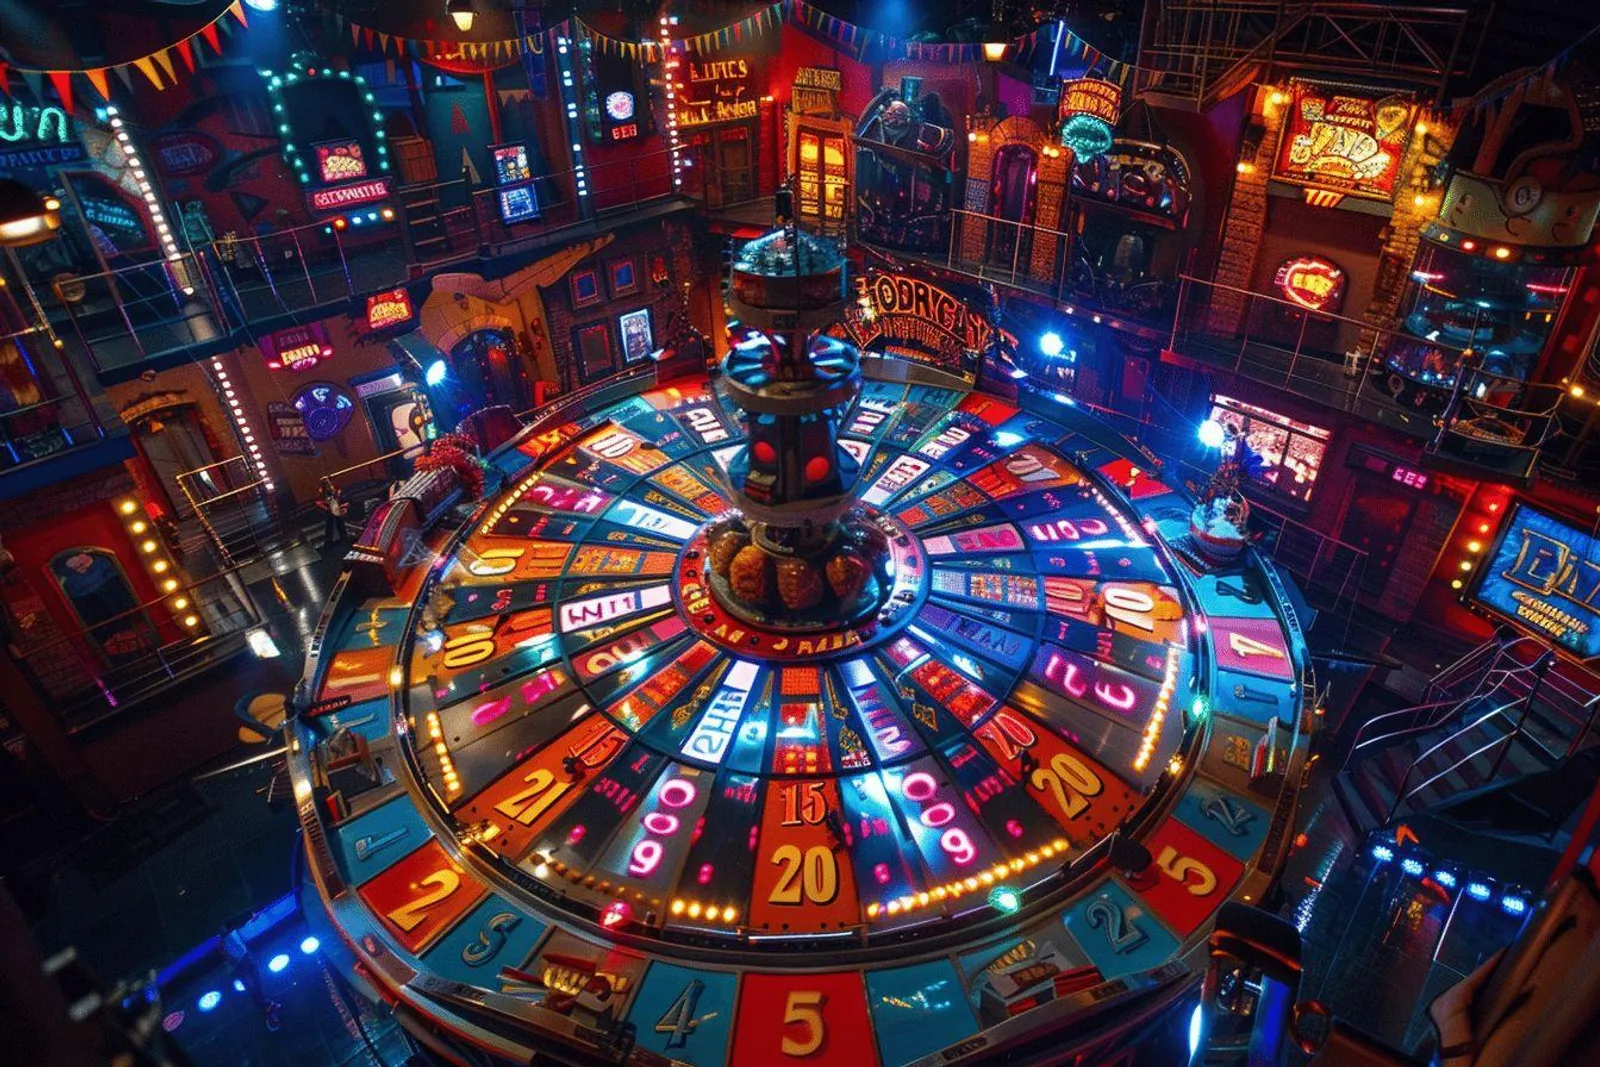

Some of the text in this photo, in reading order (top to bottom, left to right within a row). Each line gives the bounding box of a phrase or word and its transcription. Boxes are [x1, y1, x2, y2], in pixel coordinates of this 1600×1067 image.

[780, 782, 829, 827] 15
[1031, 753, 1103, 820] 20
[387, 865, 461, 933] 2
[768, 843, 838, 906] 20
[1156, 845, 1219, 897] 5
[1085, 899, 1150, 955] 2
[654, 979, 706, 1051] 4
[781, 990, 828, 1057] 5
